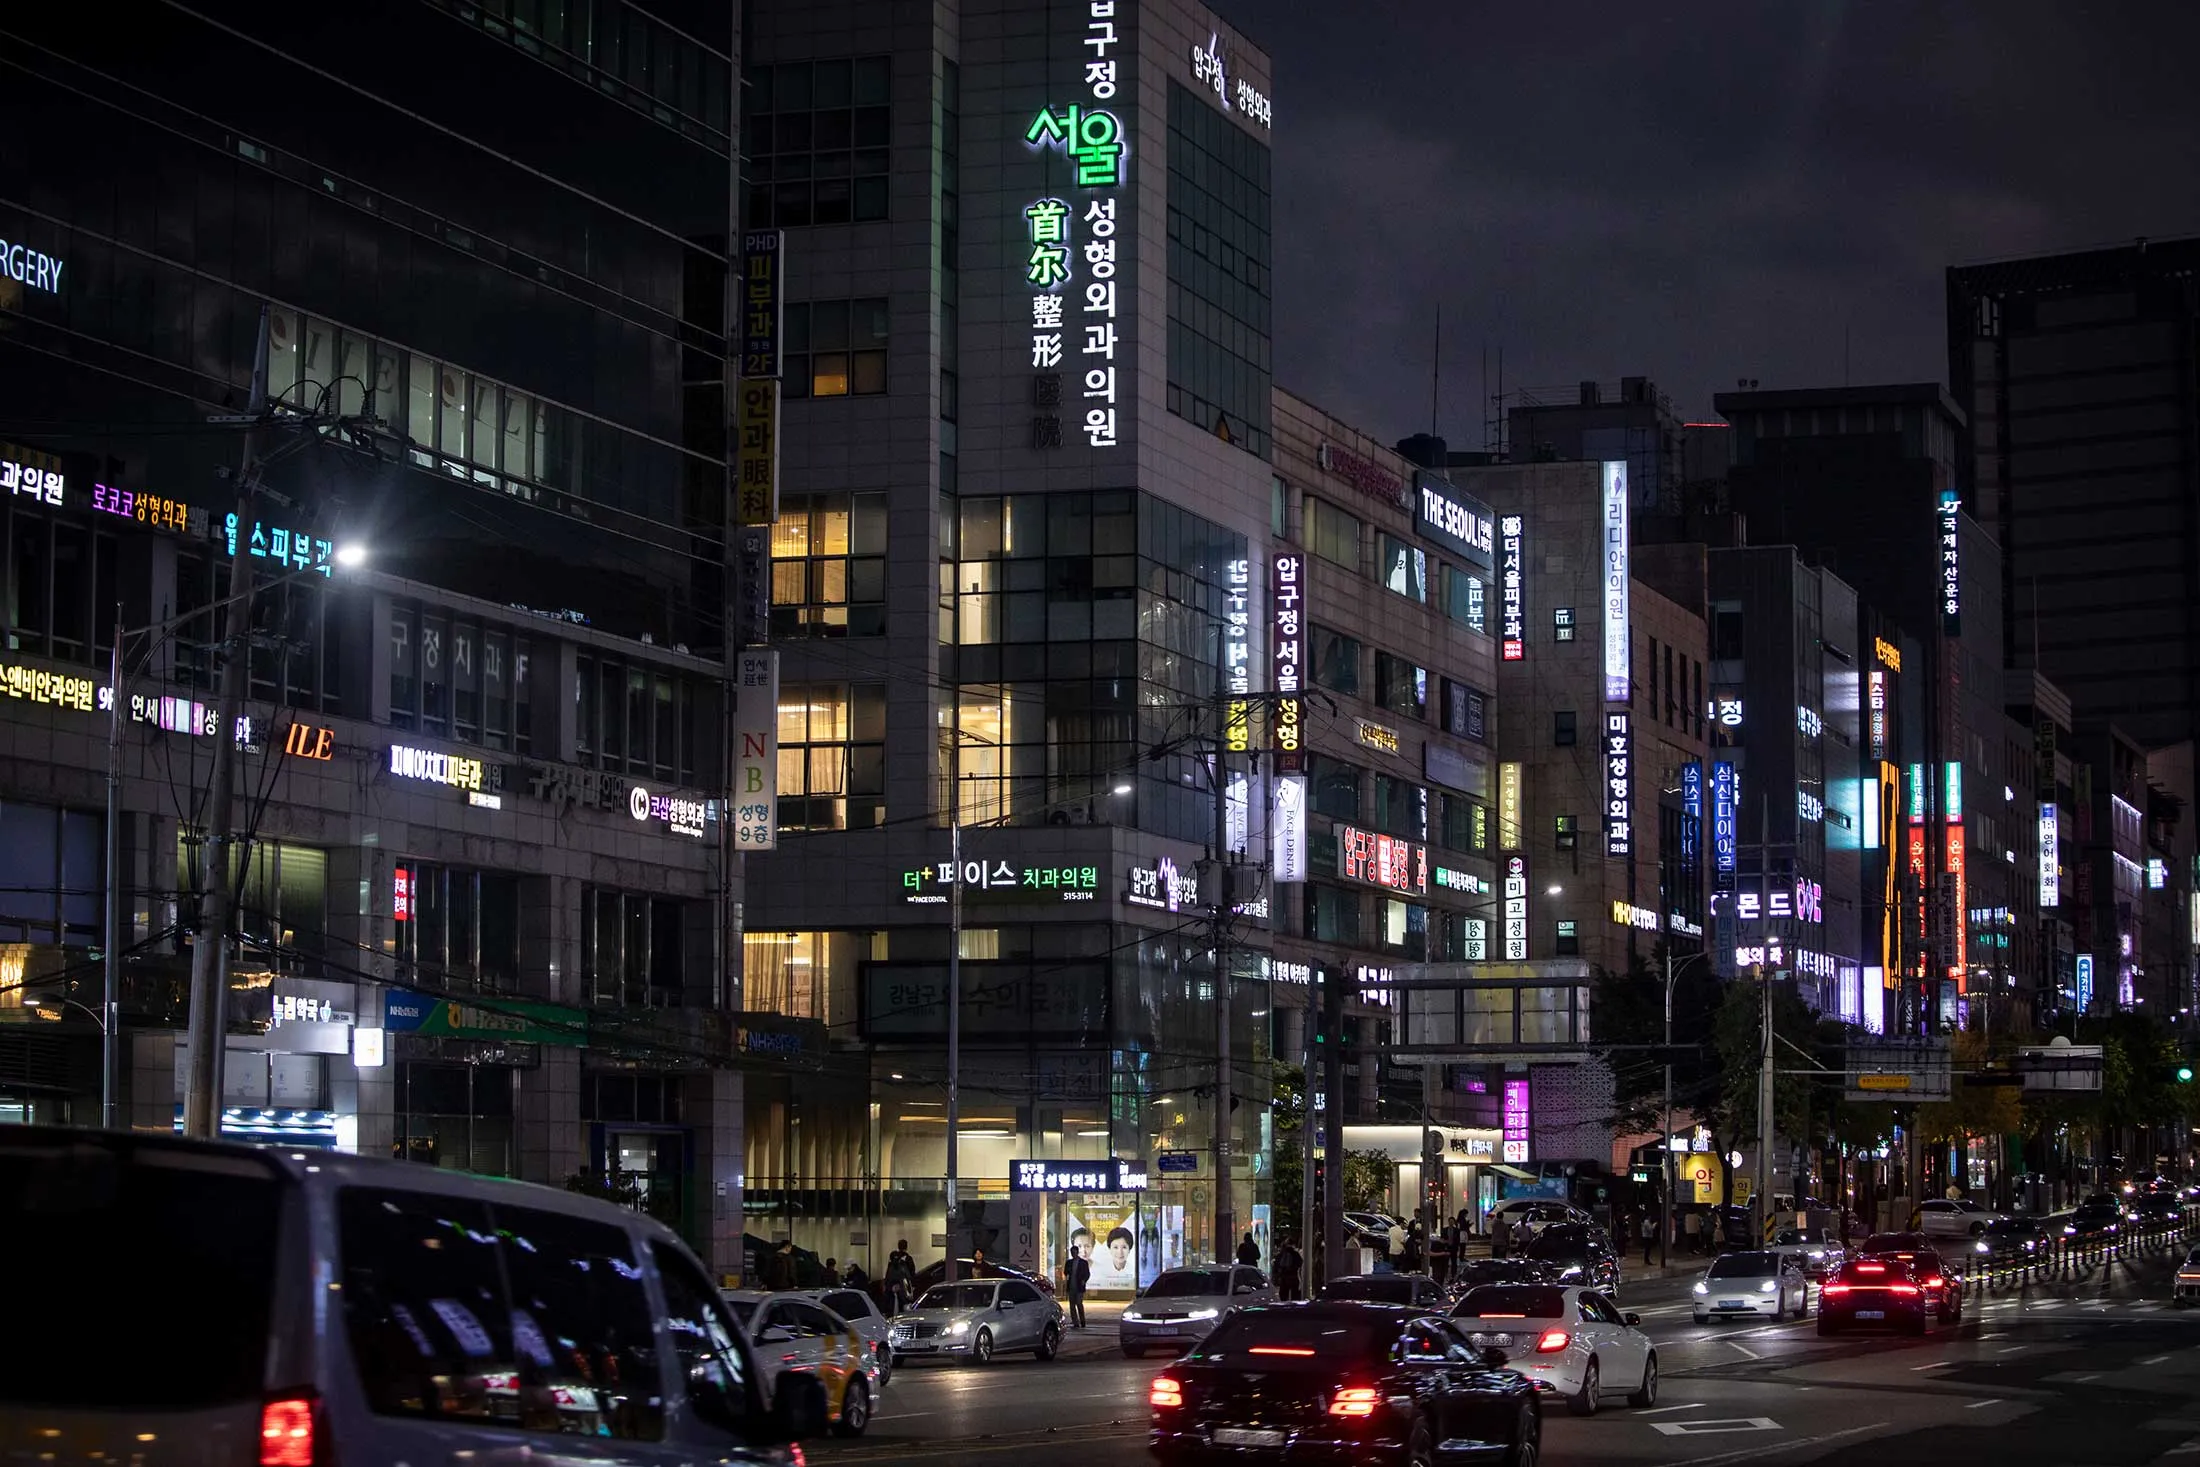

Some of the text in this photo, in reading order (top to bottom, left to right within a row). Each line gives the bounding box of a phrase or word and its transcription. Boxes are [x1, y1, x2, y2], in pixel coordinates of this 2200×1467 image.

[746, 235, 777, 251] PHD
[748, 254, 773, 339] 피부과
[1025, 104, 1119, 185] 서울
[1082, 198, 1118, 446] 성형외과의원
[747, 354, 772, 373] 2F
[744, 386, 772, 454] 안과
[93, 483, 133, 517] 로코코
[135, 492, 187, 532] 성형외과
[743, 459, 769, 517] 眼科
[1423, 488, 1478, 546] THE SEOUL
[1504, 537, 1522, 637] 더서울피부과
[1943, 517, 1959, 615] 국제자산운용
[743, 659, 768, 672] 연세
[743, 673, 768, 686] 延世
[739, 805, 769, 823] 성형
[740, 825, 768, 843] 9층
[938, 860, 1017, 889] 페이스
[1023, 867, 1097, 889] 치과의원
[1133, 866, 1157, 897] 압구정
[1159, 857, 1178, 912] 서울
[2043, 833, 2056, 888] 영어회화
[1508, 880, 1524, 957] 미고성형
[1507, 1142, 1524, 1161] 약
[1696, 1168, 1715, 1192] 약
